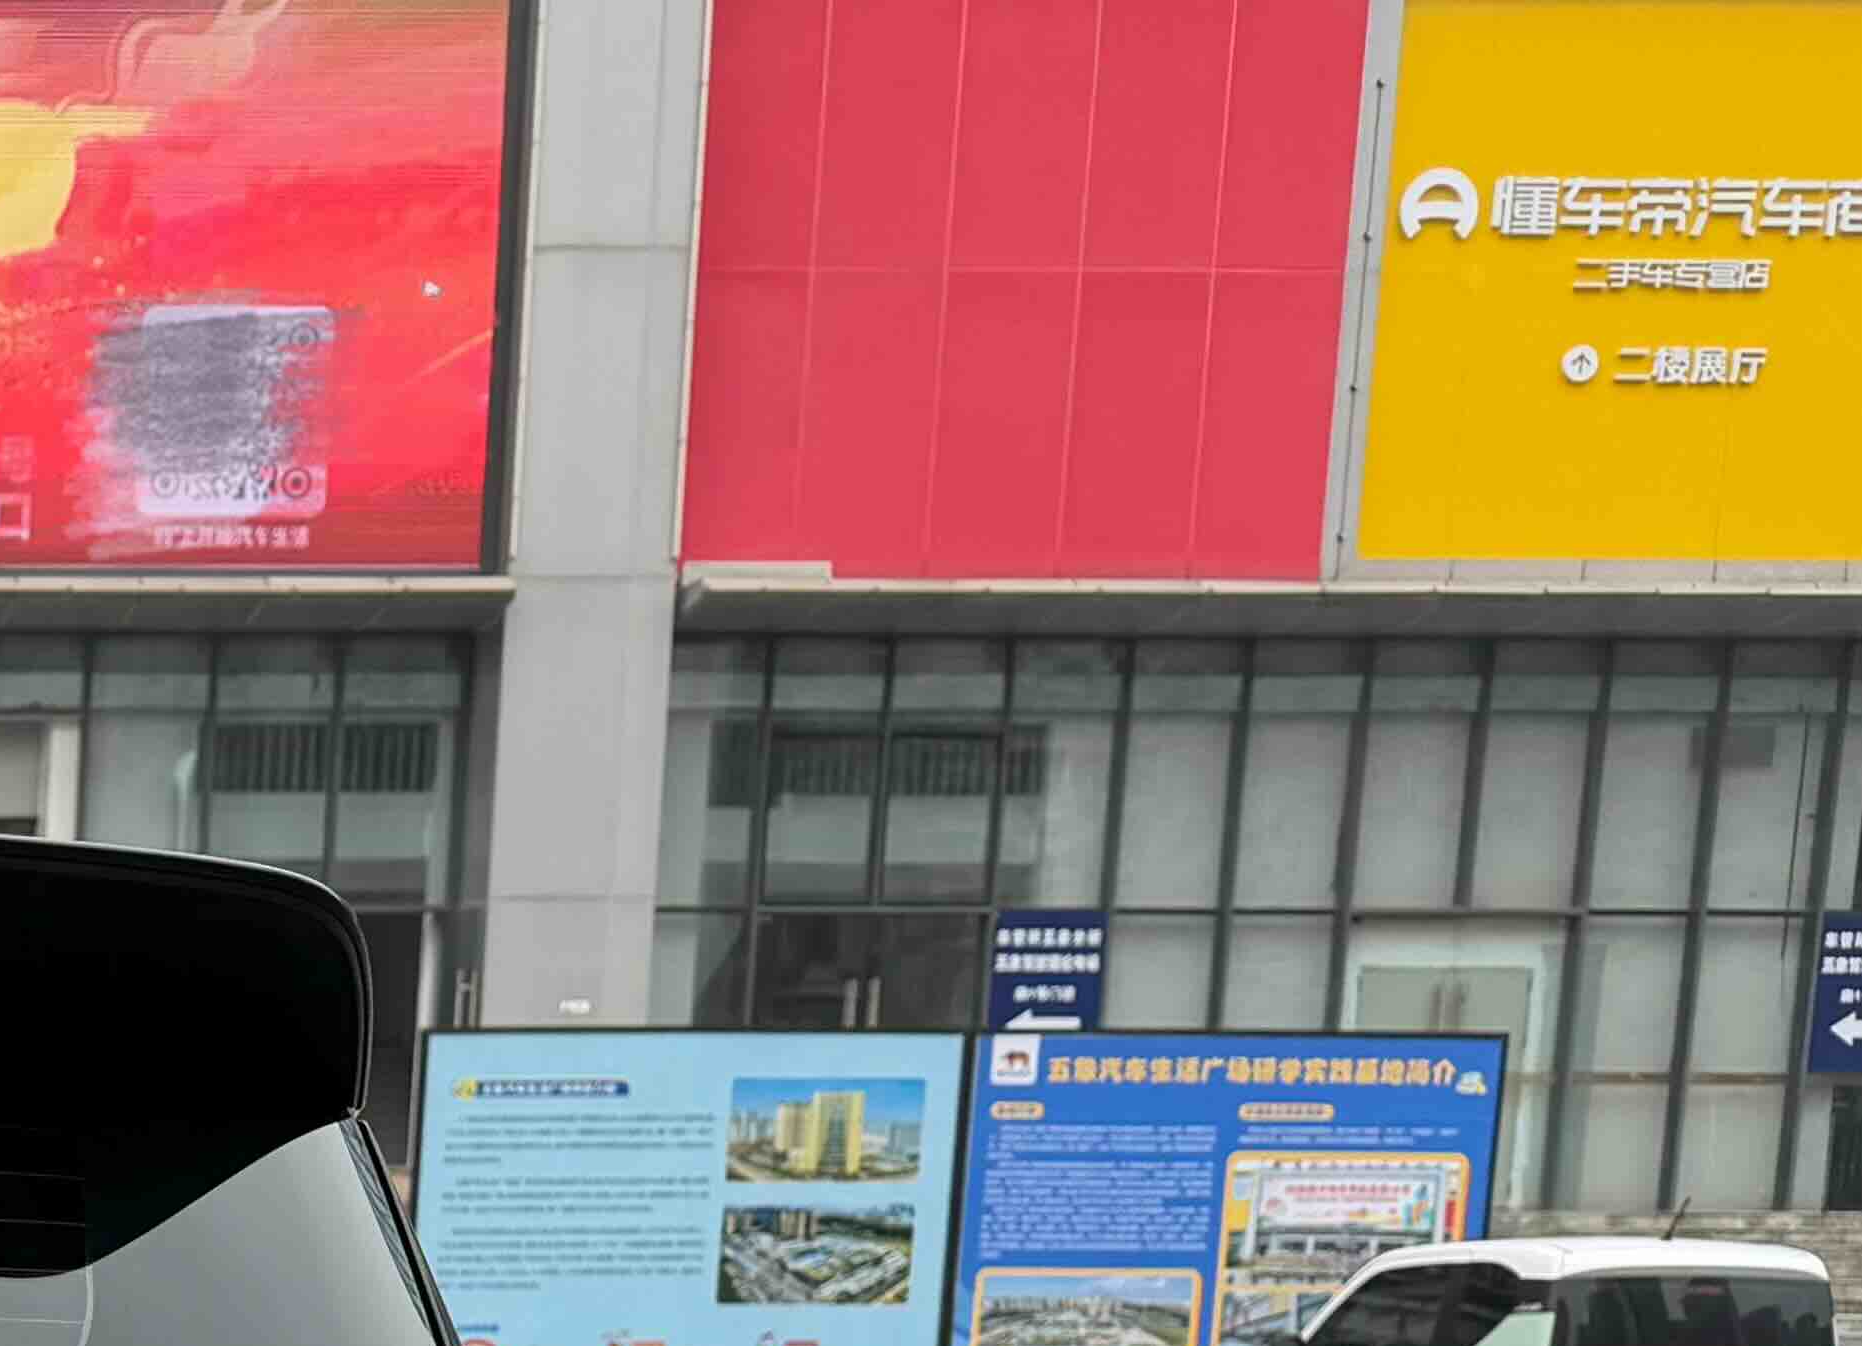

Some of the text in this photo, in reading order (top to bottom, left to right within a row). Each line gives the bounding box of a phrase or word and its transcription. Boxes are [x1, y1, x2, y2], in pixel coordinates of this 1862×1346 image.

[1573, 259, 1770, 290] 二手车专营店
[1614, 346, 1766, 384] 二楼展厅
